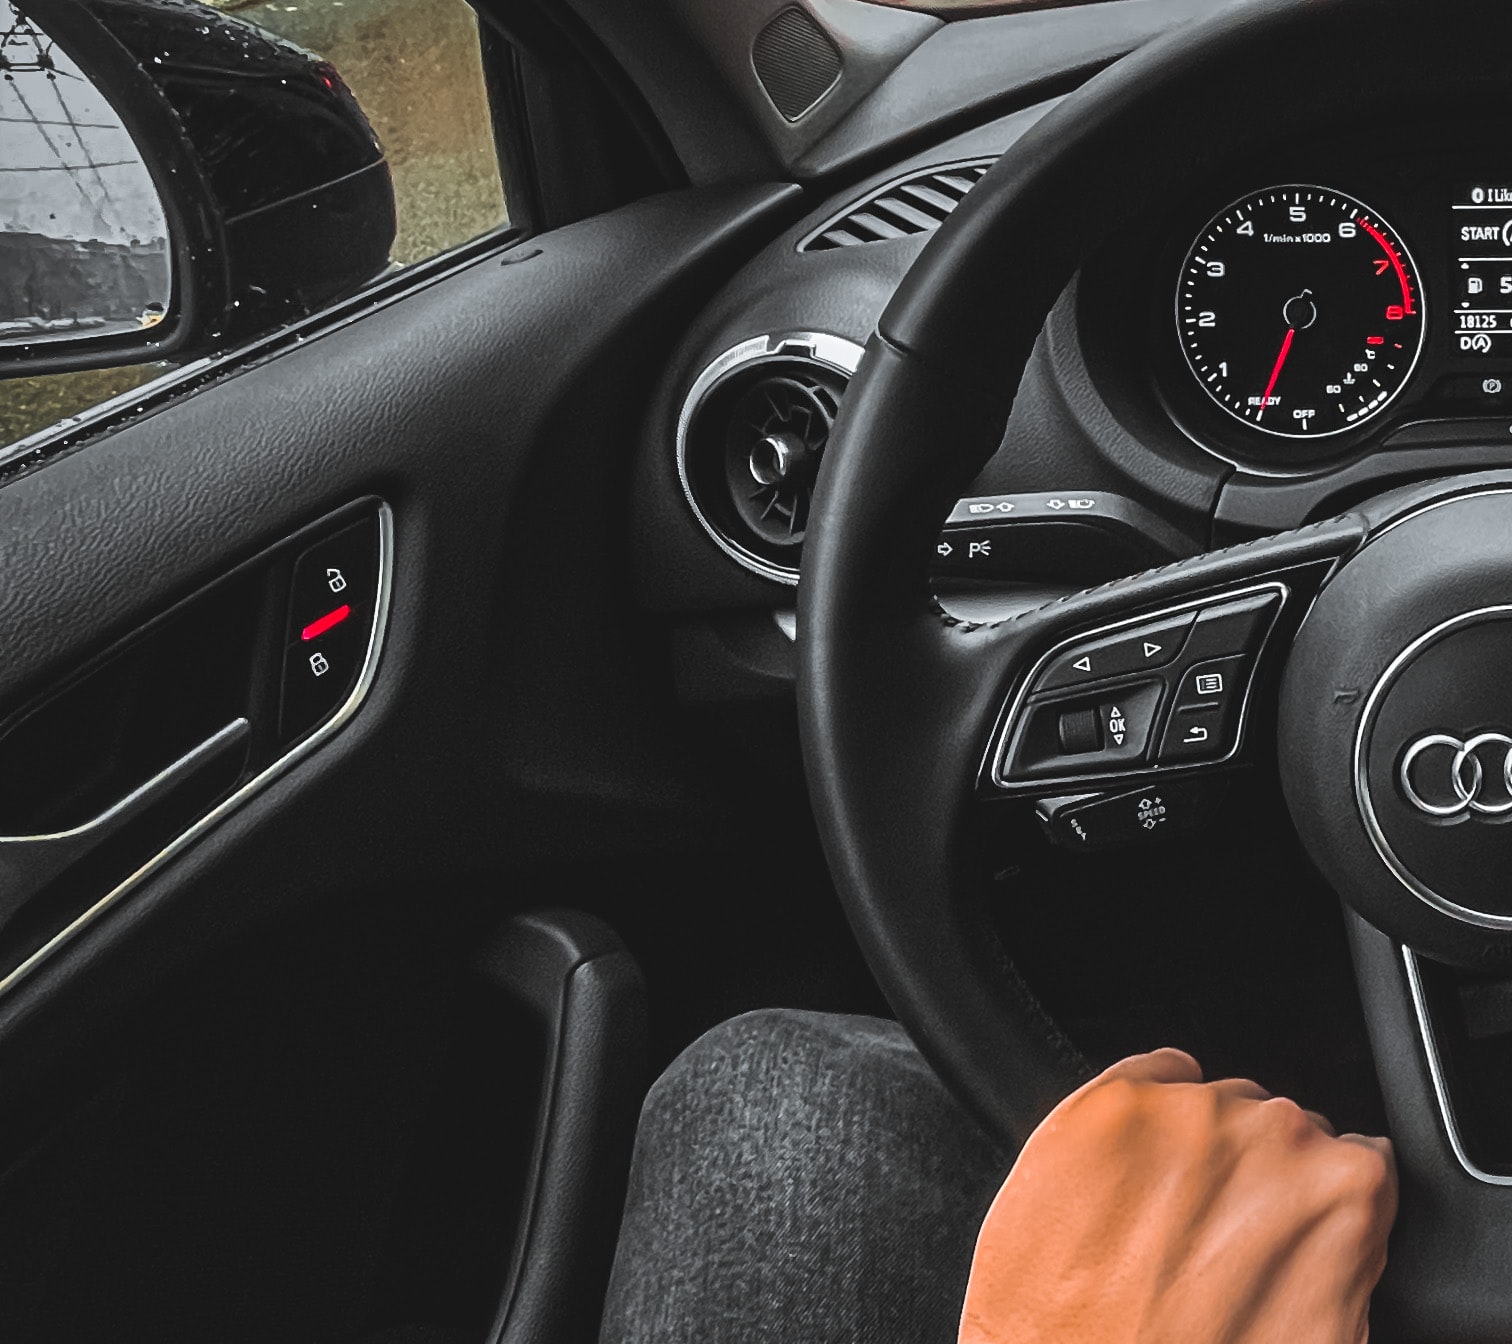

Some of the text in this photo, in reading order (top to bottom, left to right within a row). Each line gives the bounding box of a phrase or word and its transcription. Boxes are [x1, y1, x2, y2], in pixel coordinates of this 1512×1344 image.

[1288, 206, 1307, 223] 5
[1235, 220, 1254, 237] 4
[1338, 221, 1357, 238] 6
[1460, 226, 1500, 241] START
[1206, 261, 1225, 277] 3
[1372, 259, 1390, 276] 7
[1198, 311, 1216, 327] 2
[1385, 305, 1404, 320] 8
[1459, 314, 1497, 328] 18125
[1459, 336, 1472, 350] D
[1218, 361, 1229, 377] 1
[1248, 396, 1282, 406] READY
[1292, 409, 1316, 419] OFF
[1109, 717, 1126, 733] OK
